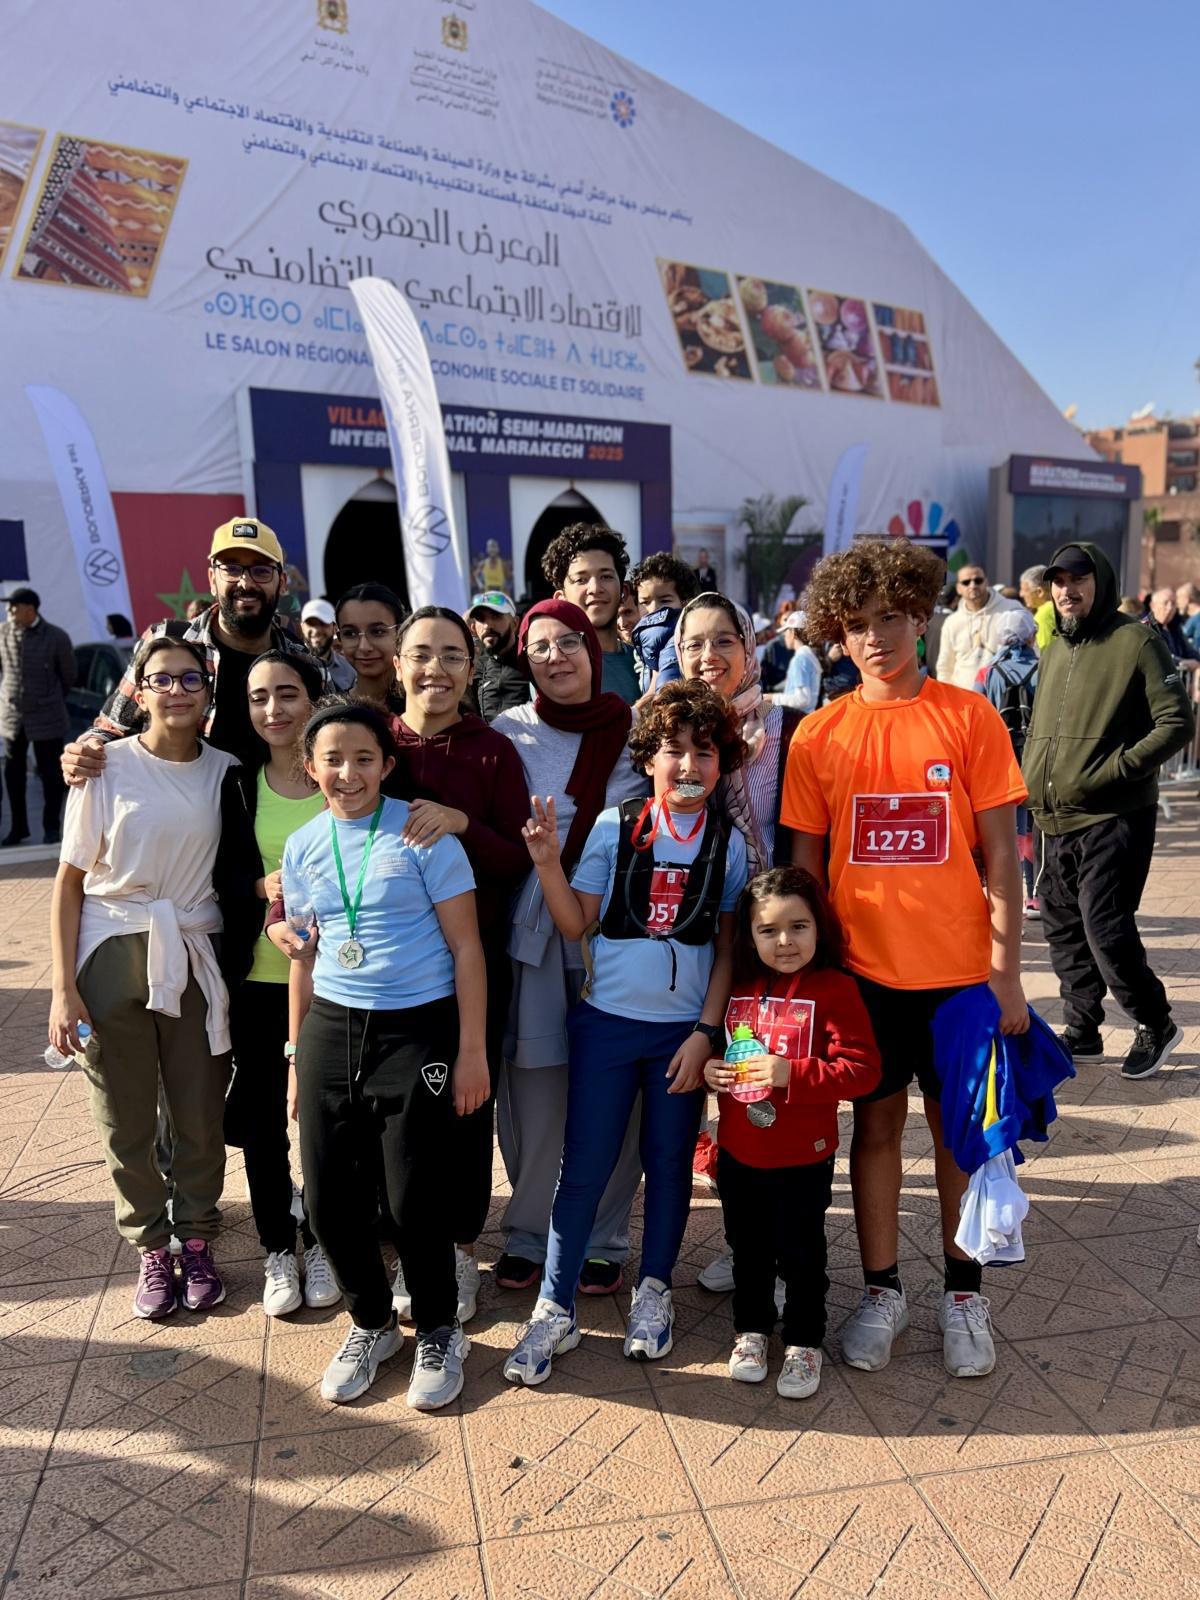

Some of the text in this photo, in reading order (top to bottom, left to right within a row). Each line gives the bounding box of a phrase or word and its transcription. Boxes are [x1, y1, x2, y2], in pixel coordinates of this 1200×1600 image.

[107, 74, 180, 105] والتضامني
[183, 96, 249, 119] الاجتماعي
[253, 109, 313, 136] والاقتصاد
[317, 122, 374, 145] التقليدية
[241, 133, 306, 159] والتضامني
[432, 147, 475, 169] السياحة
[309, 149, 367, 171] الاجتماعي
[318, 200, 560, 267] المعرض الجهوي
[206, 247, 642, 339] للاقتصاد الاجتماعي التضامني
[205, 332, 227, 350] LE
[231, 335, 290, 358] SALON
[296, 341, 373, 368] RÉGIONA
[430, 359, 497, 382] CONOMIE
[501, 369, 558, 391] SOCIALE
[561, 377, 577, 393] ET
[579, 380, 645, 401] SOLIDAIRE
[327, 405, 624, 443] VILLA ATHON SEMI-MARATHON
[481, 437, 585, 459] MARRAKECH
[866, 829, 926, 851] 1273
